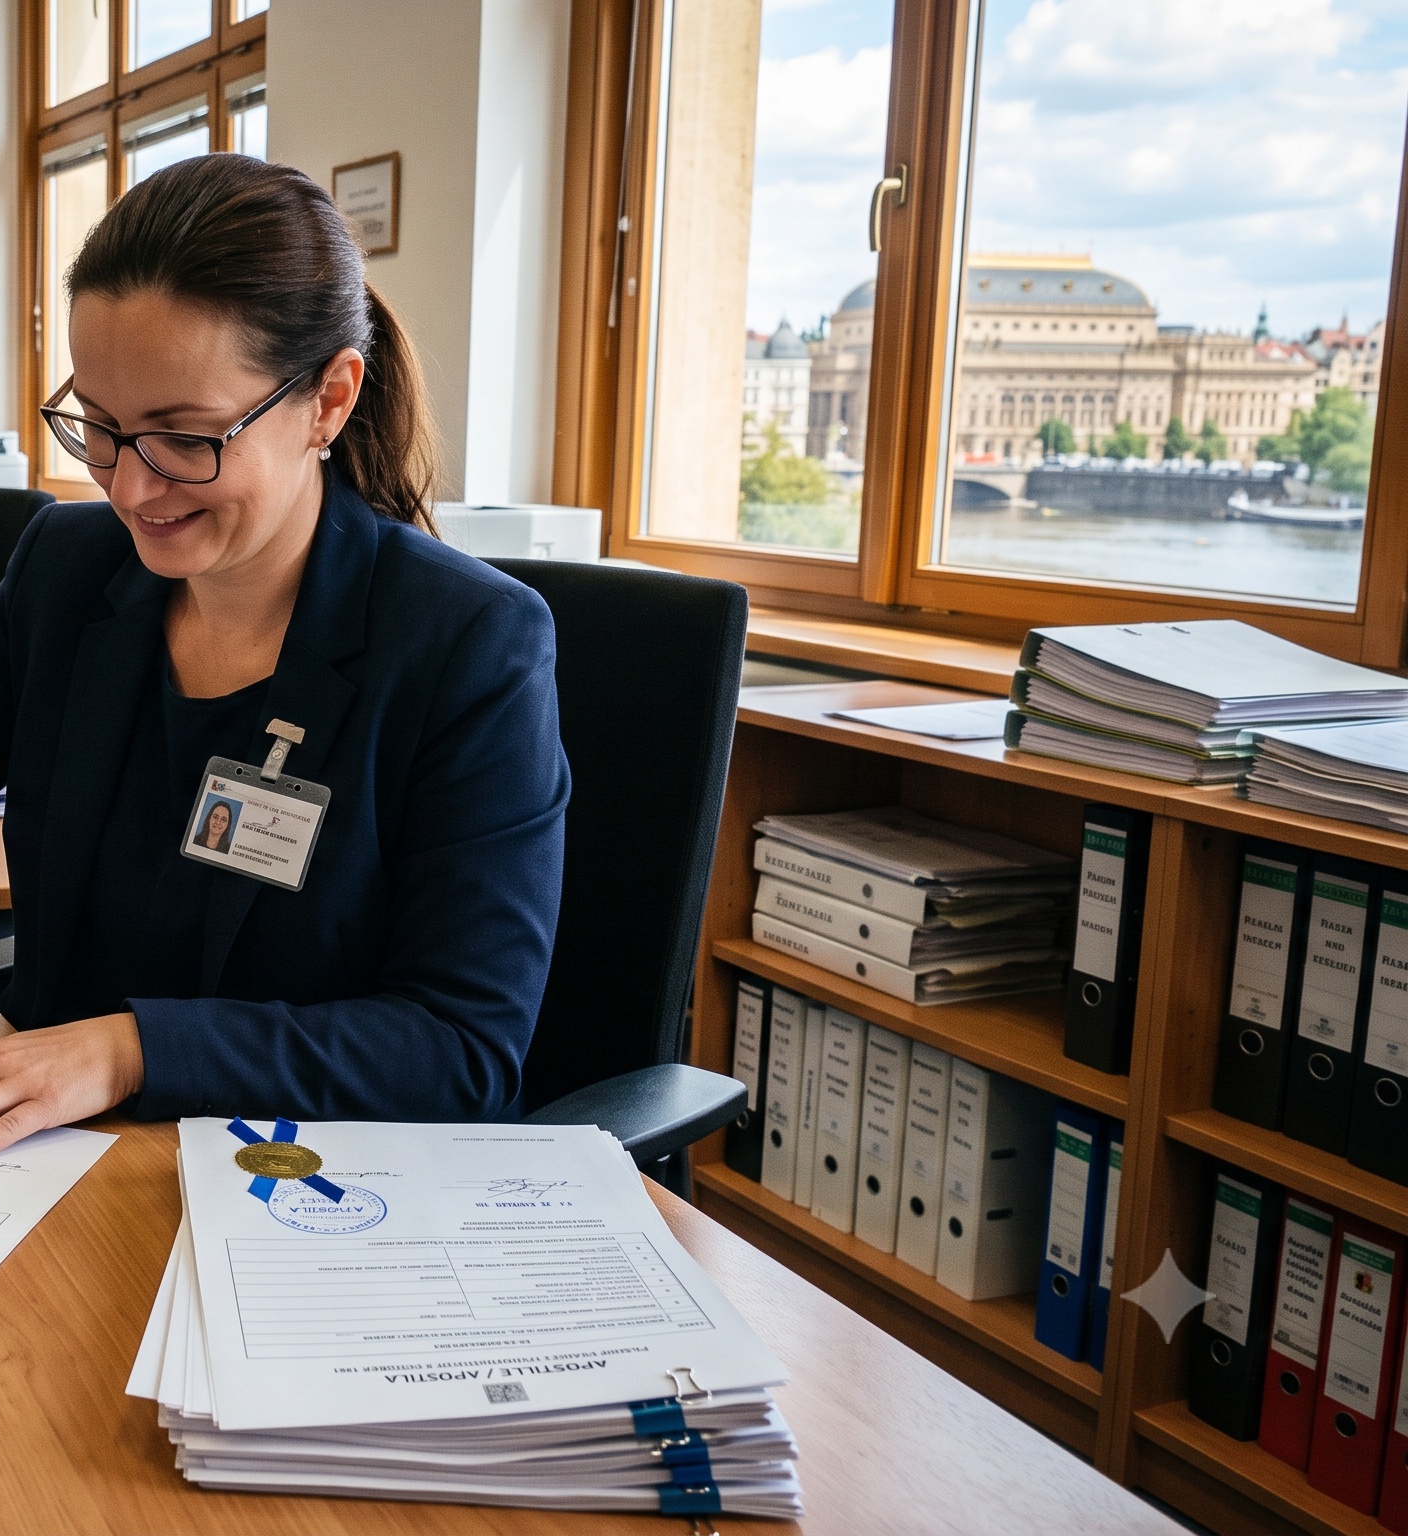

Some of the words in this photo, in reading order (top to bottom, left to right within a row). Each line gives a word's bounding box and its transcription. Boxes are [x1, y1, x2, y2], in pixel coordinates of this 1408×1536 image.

[486, 1368, 494, 1379] /
[500, 1359, 607, 1377] APOSTILLE
[384, 1369, 480, 1384] APOSTILA
